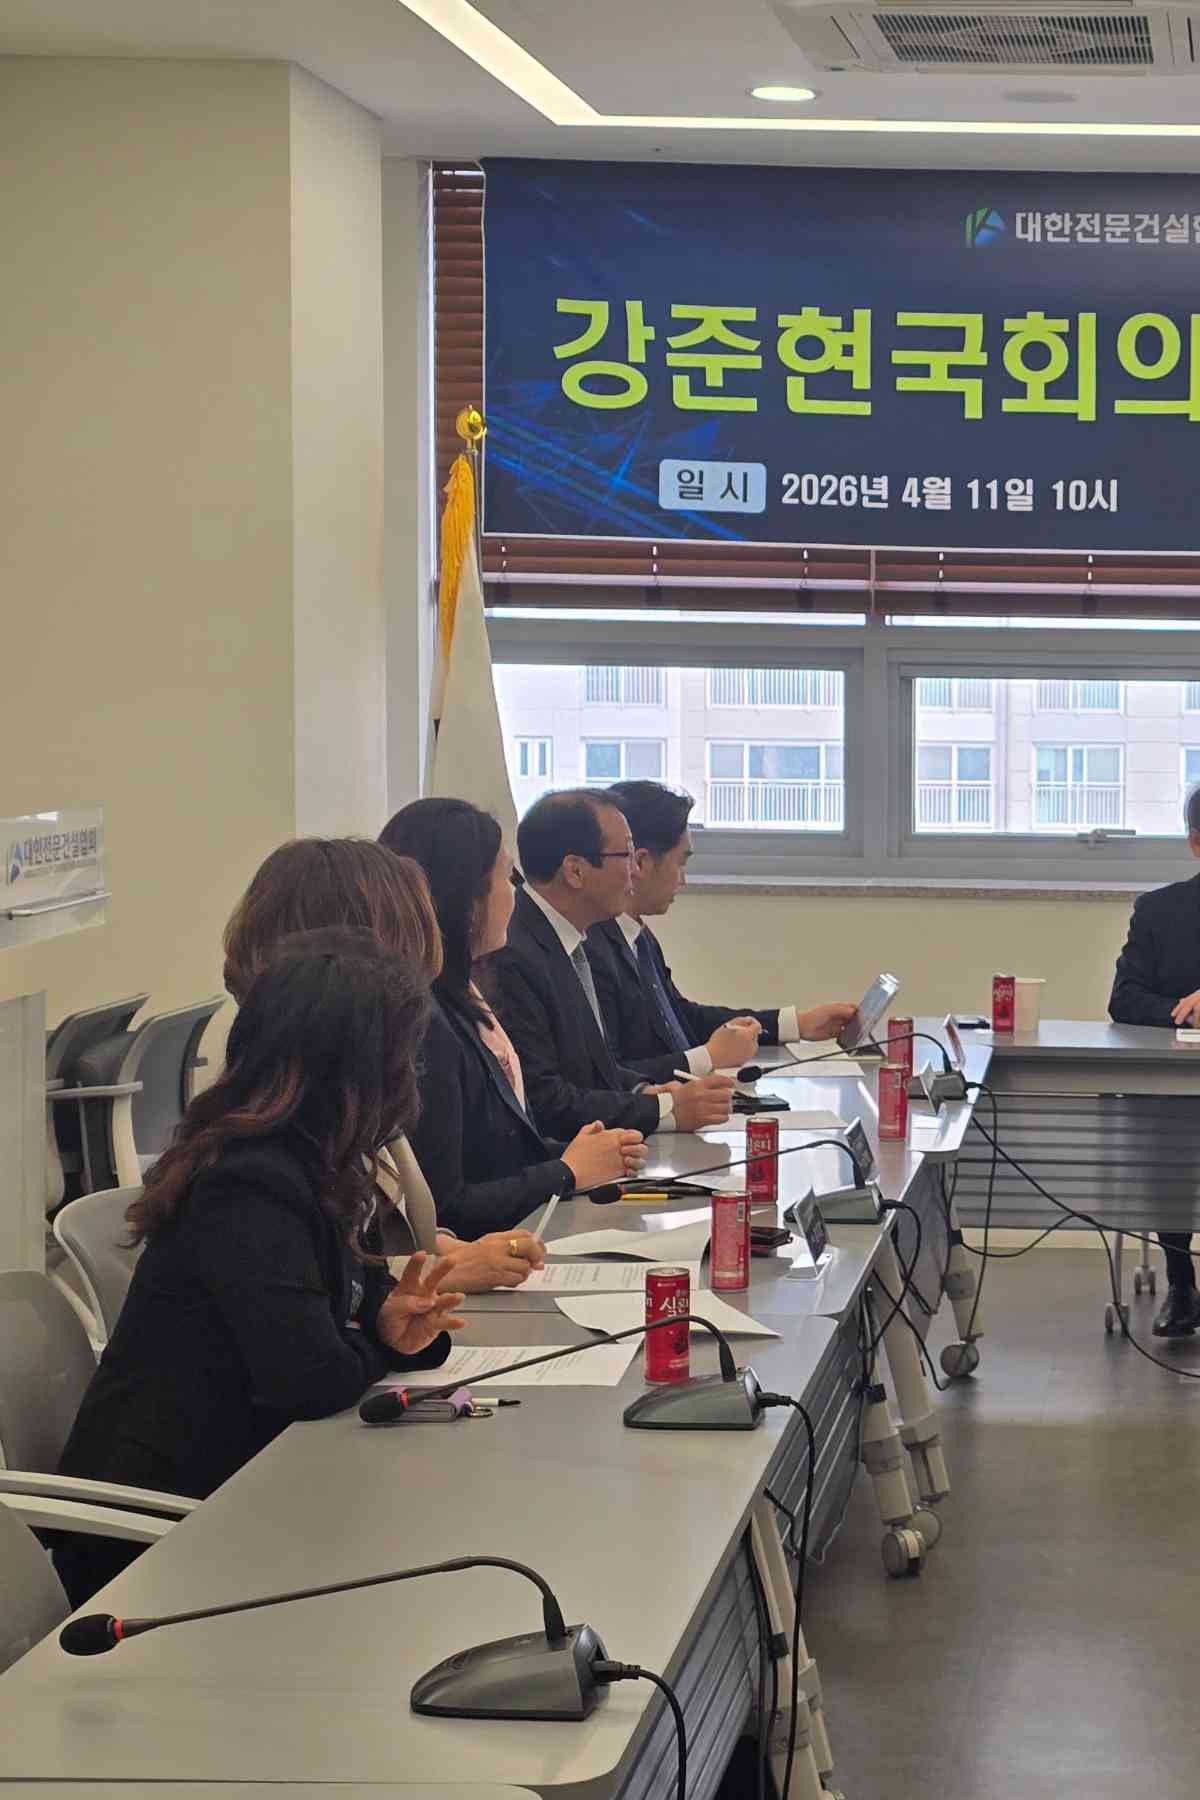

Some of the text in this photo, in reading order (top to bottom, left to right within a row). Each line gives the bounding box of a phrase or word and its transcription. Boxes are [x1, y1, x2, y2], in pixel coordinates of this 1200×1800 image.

[781, 472, 1118, 513] 2026년 4월 11일 10시
